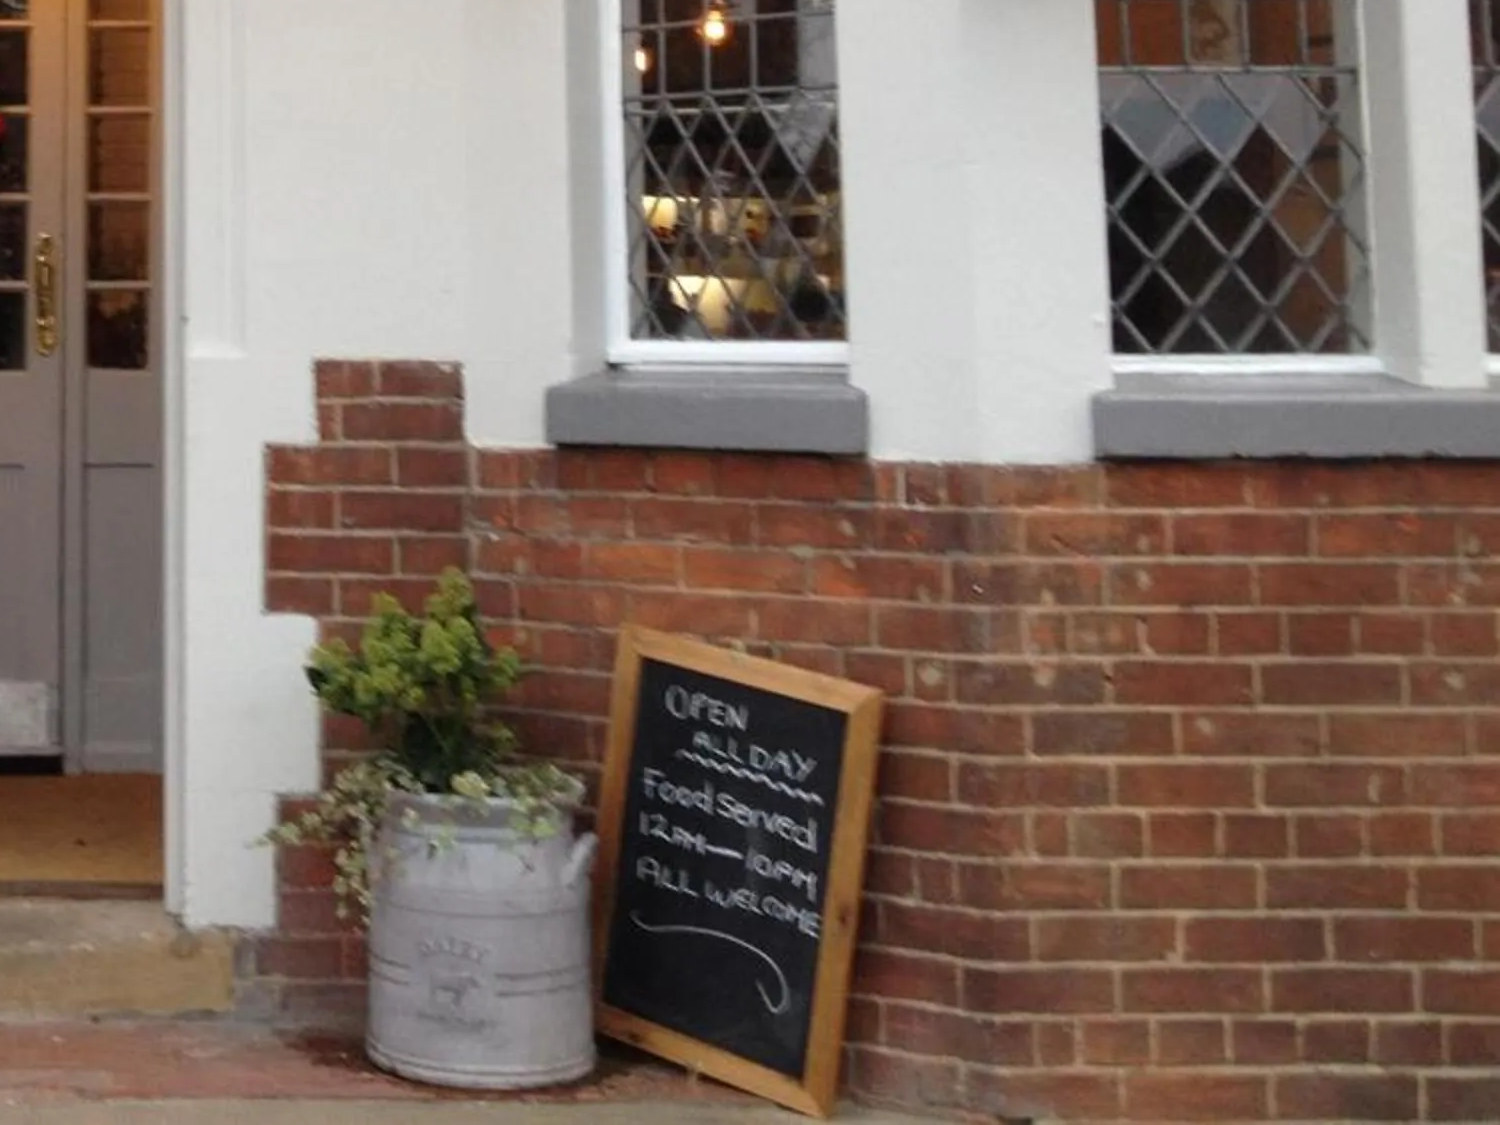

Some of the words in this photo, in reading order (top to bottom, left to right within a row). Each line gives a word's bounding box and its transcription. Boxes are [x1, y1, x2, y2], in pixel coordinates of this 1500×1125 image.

[664, 684, 749, 732] OPEN
[693, 731, 744, 765] ALL
[749, 743, 818, 783] DAY
[643, 767, 715, 815] Food
[716, 791, 818, 854] Served
[636, 856, 699, 898] ALL
